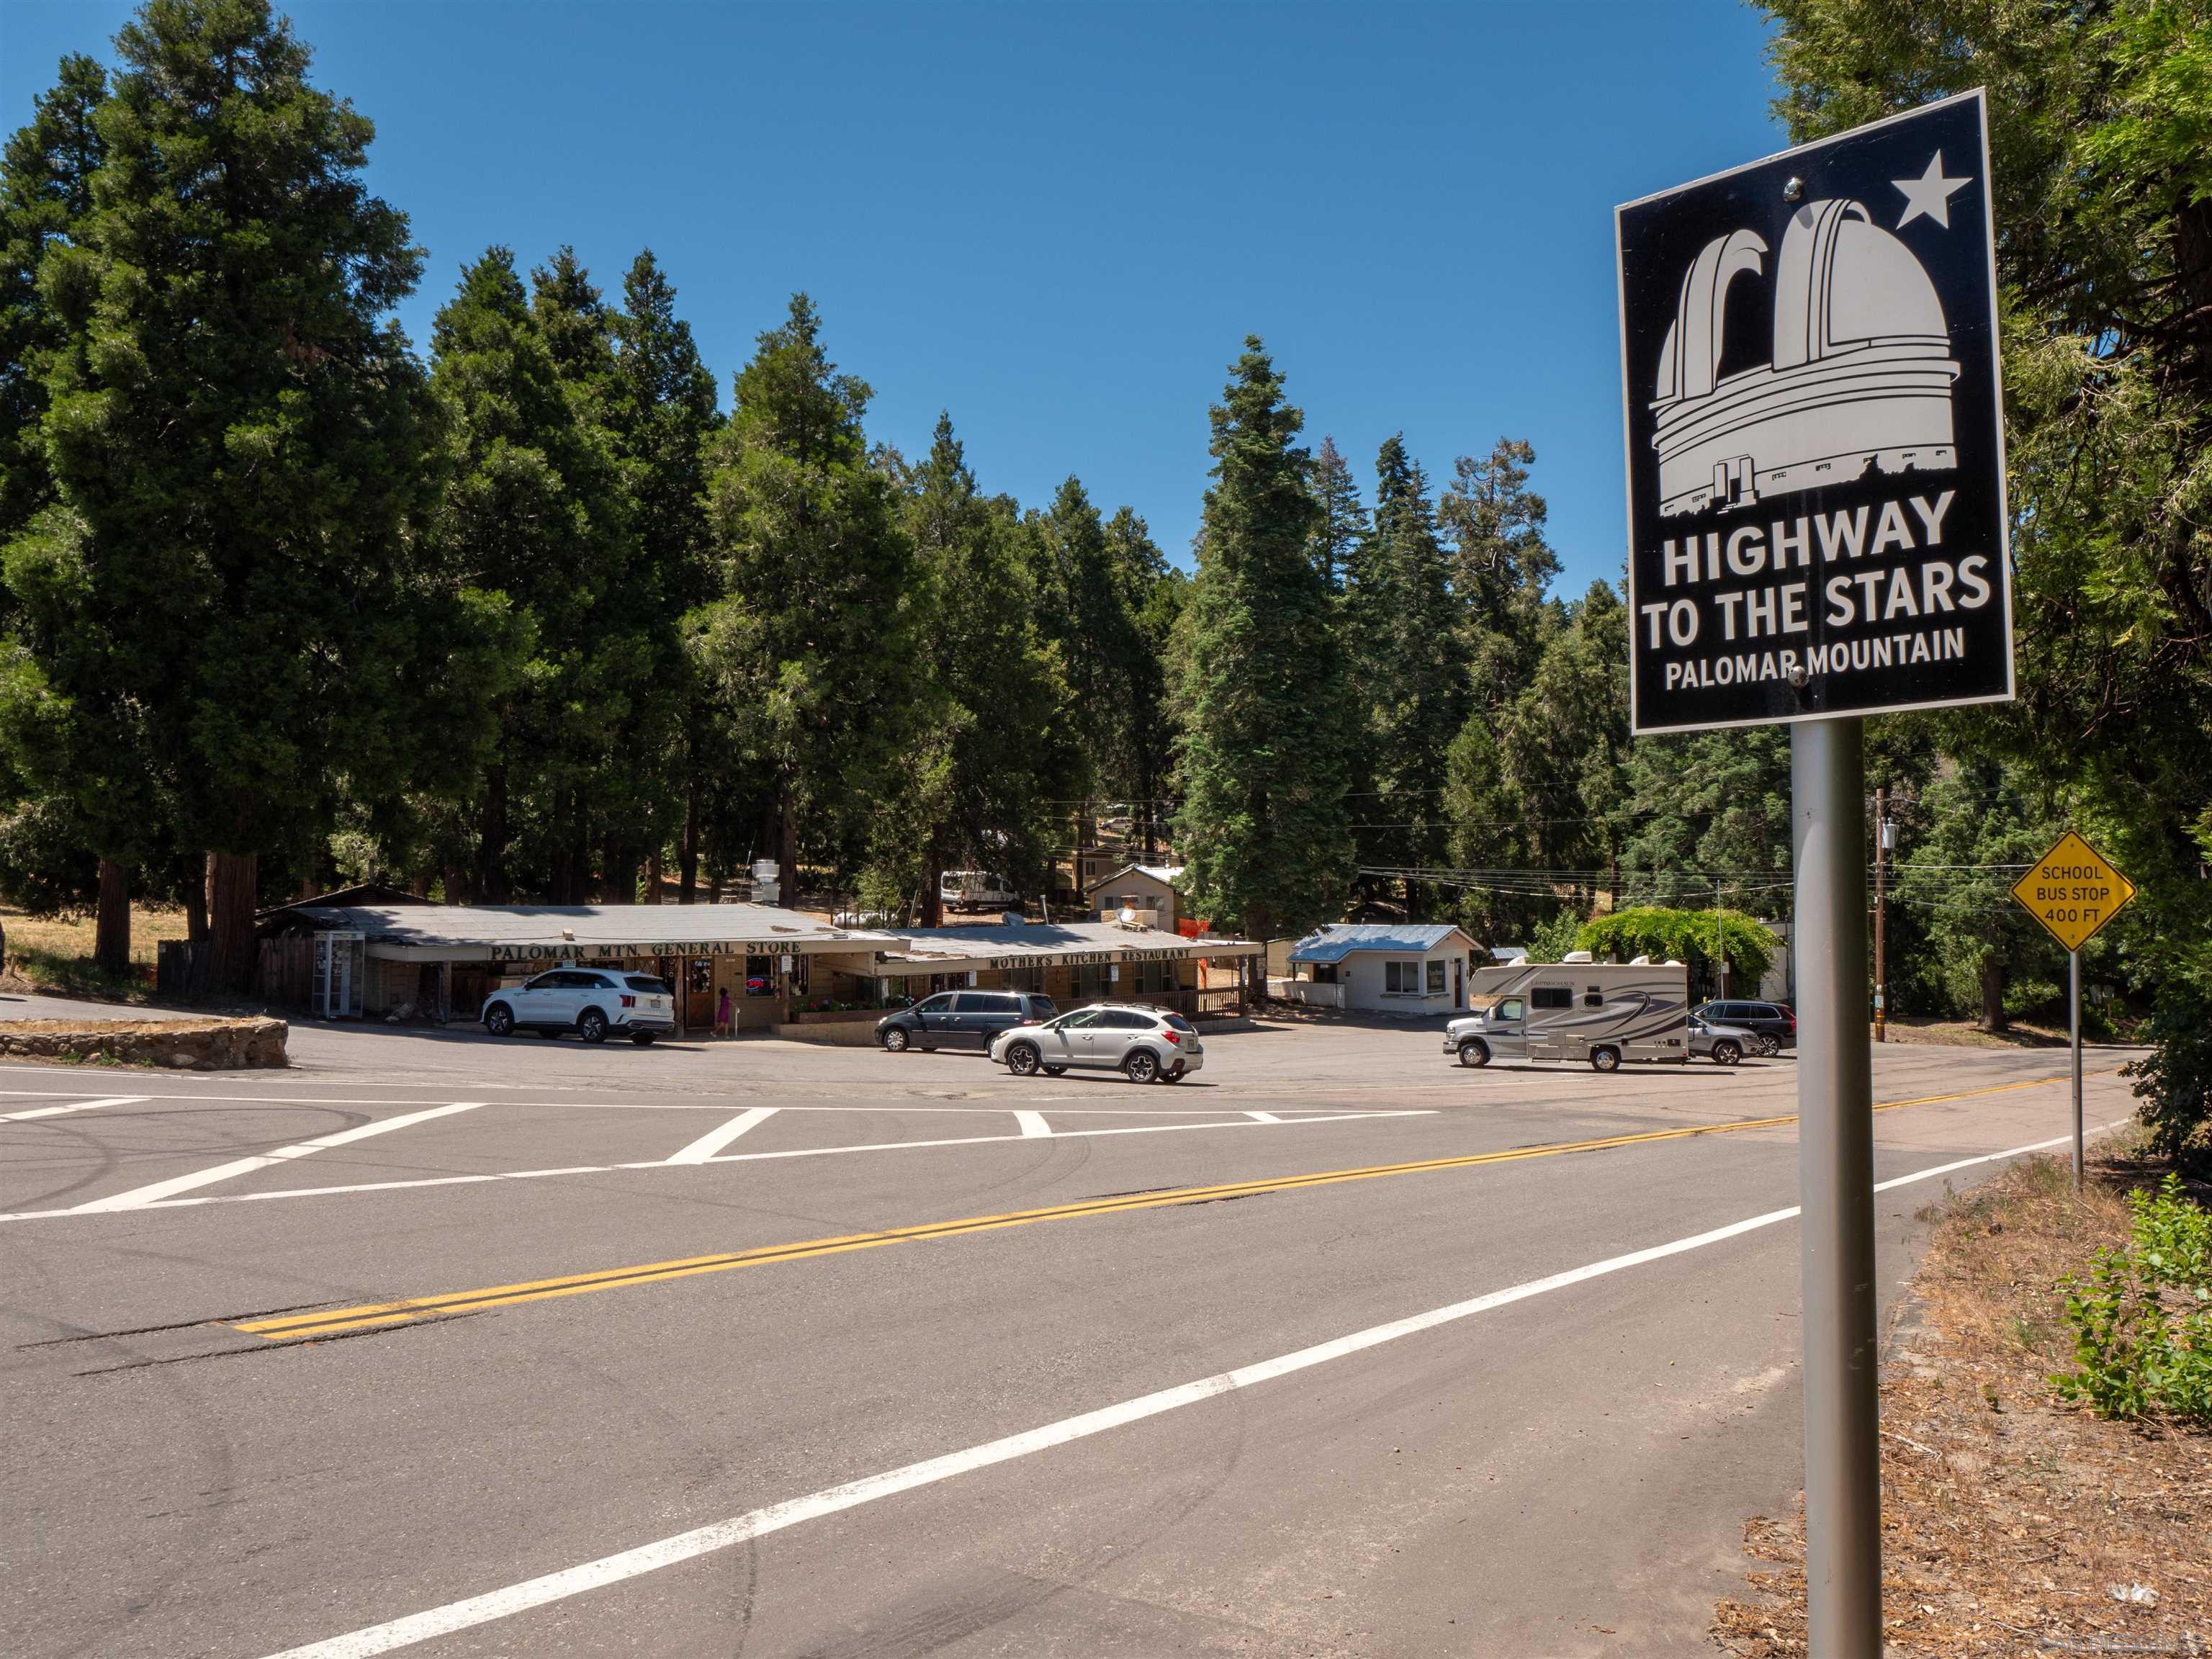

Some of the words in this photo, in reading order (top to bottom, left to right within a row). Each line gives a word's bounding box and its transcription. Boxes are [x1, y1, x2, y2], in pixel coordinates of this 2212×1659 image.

[1663, 490, 1956, 586] HIGHWAY
[1642, 599, 1699, 649] TO
[1715, 583, 1809, 640] THE
[1825, 555, 1991, 627] STARS
[1665, 649, 1797, 691] PALOMAR
[1807, 627, 1965, 675] MOUNTAIN
[2041, 866, 2103, 879] SCHOOL
[2036, 887, 2067, 901] BUS
[2072, 887, 2110, 901] STOP
[2045, 909, 2077, 922] 400
[2083, 909, 2100, 922] FT
[491, 945, 585, 960] PALOMAR
[598, 944, 641, 958] MTN.
[651, 942, 734, 956] GENERAL
[746, 940, 801, 954] STORE
[989, 955, 1053, 969] MOTHER'S
[1062, 951, 1112, 966] KITCHEN
[1121, 948, 1191, 962] RESTAURANT
